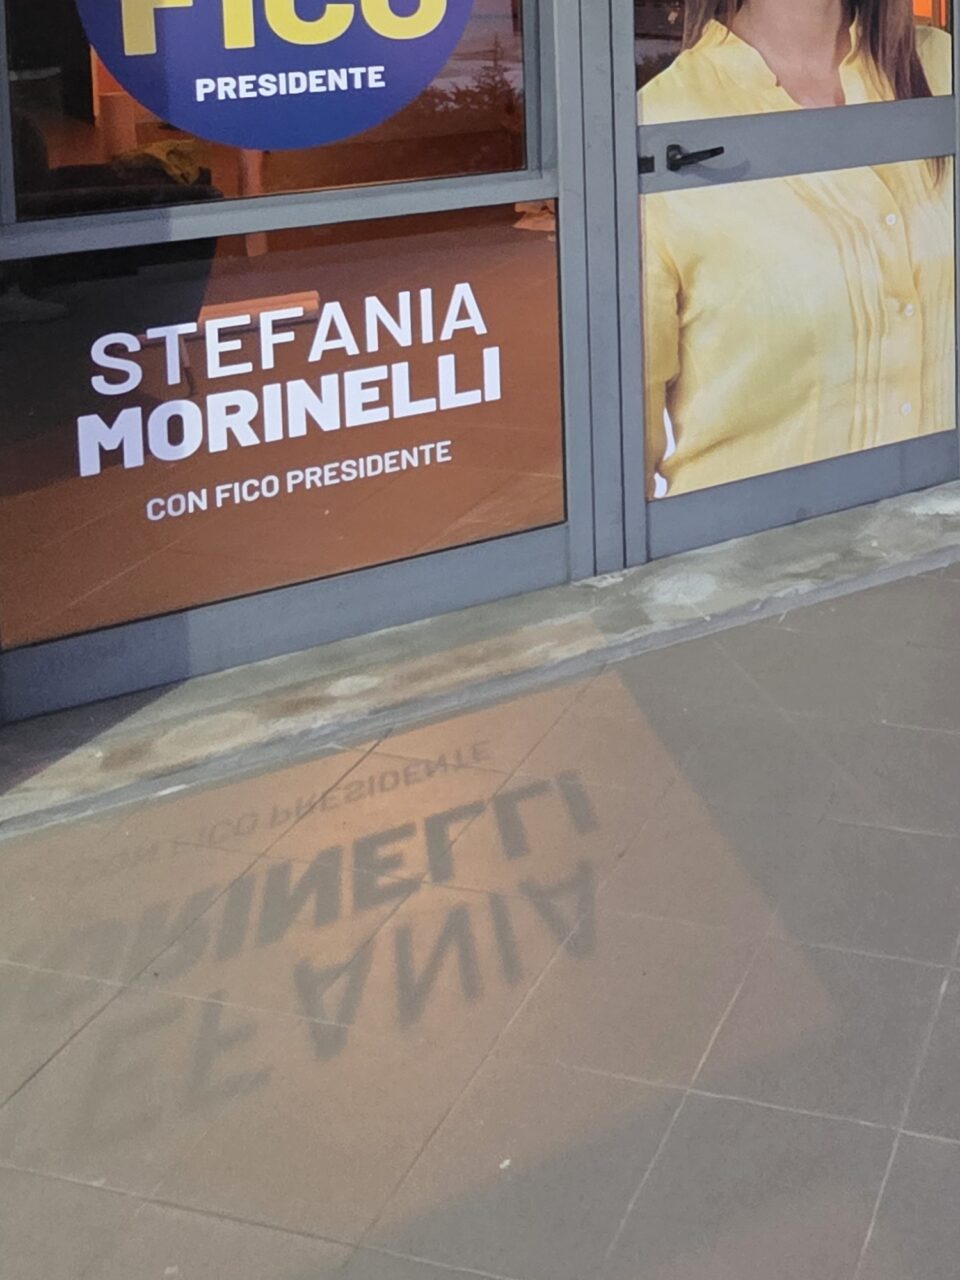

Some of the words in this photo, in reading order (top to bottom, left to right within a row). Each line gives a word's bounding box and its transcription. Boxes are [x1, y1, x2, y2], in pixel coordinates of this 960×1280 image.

[195, 65, 387, 103] PRESIDENTE
[90, 282, 488, 396] STEFANIA
[76, 346, 502, 478] MORINELLI
[146, 487, 208, 521] CON
[215, 473, 281, 509] FICO
[286, 440, 453, 494] PRESIDENTE
